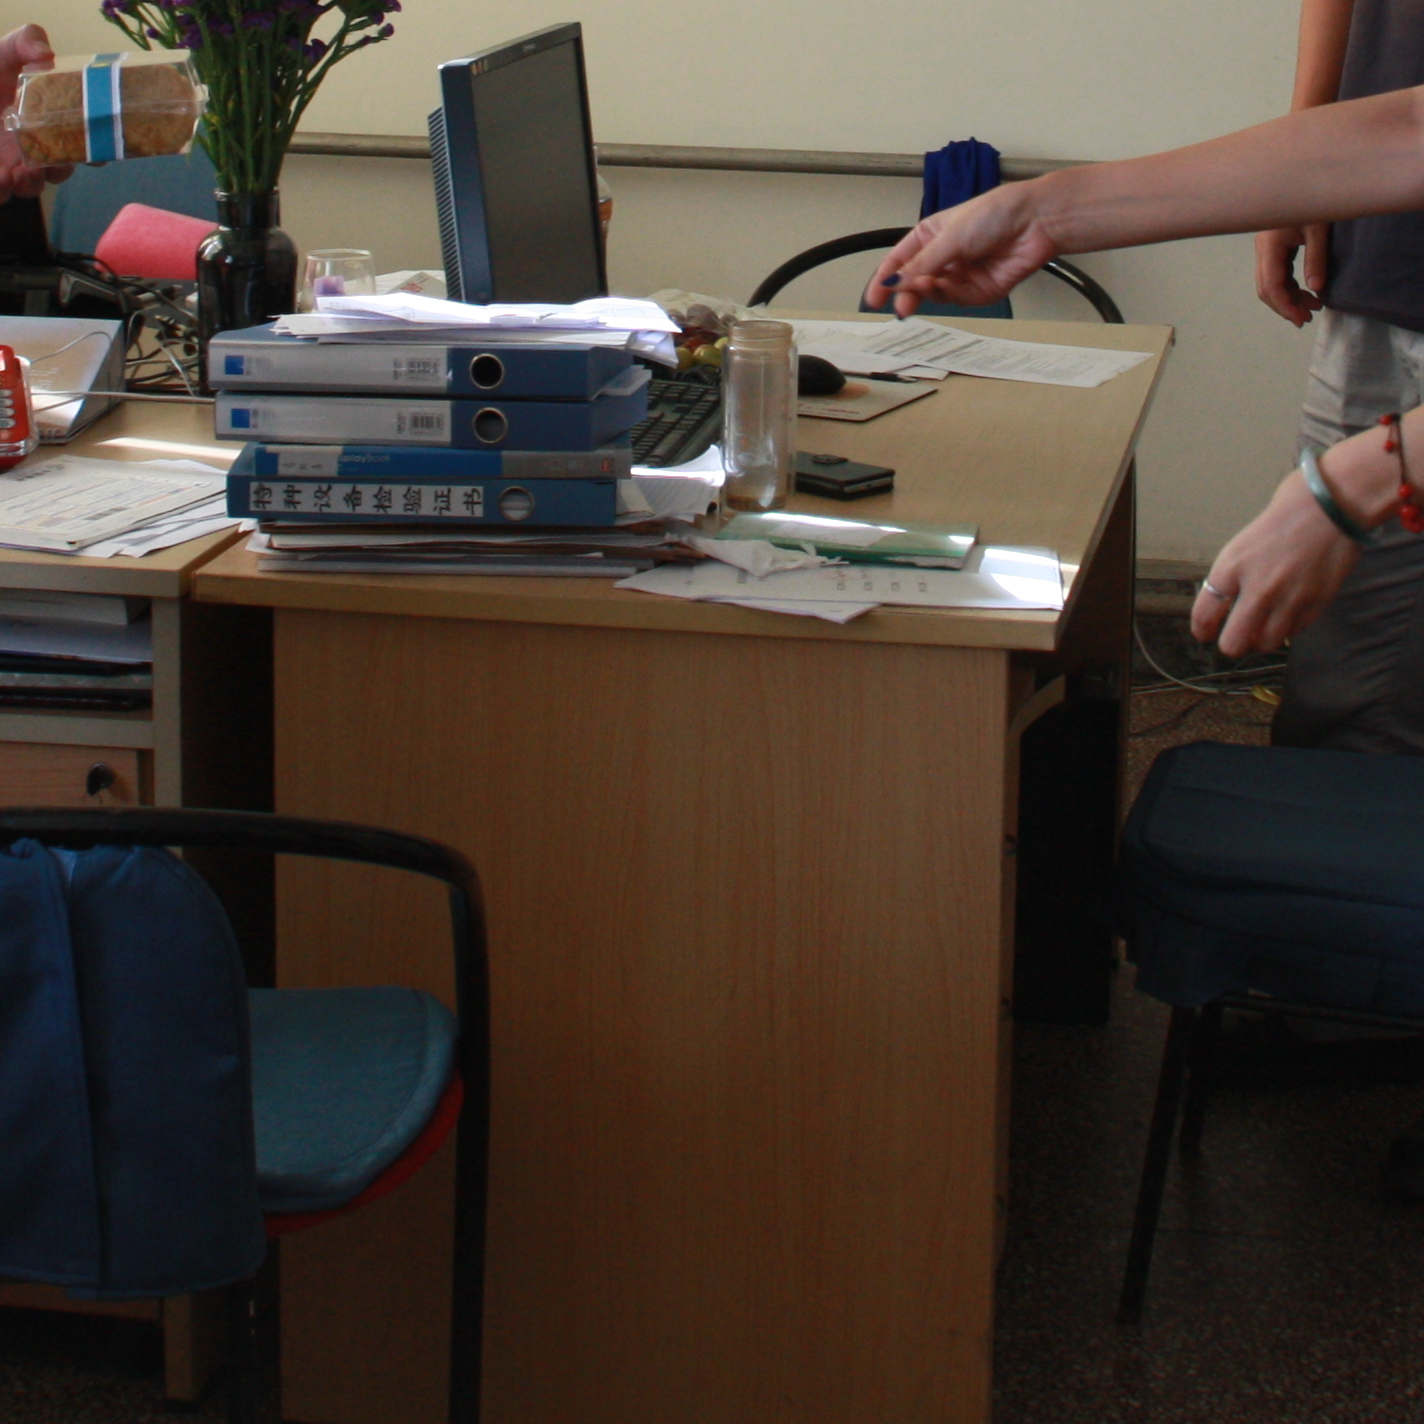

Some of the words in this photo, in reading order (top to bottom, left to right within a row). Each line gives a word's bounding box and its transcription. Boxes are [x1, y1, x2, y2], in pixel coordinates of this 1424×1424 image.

[253, 483, 483, 517] 特种设备检验证书
